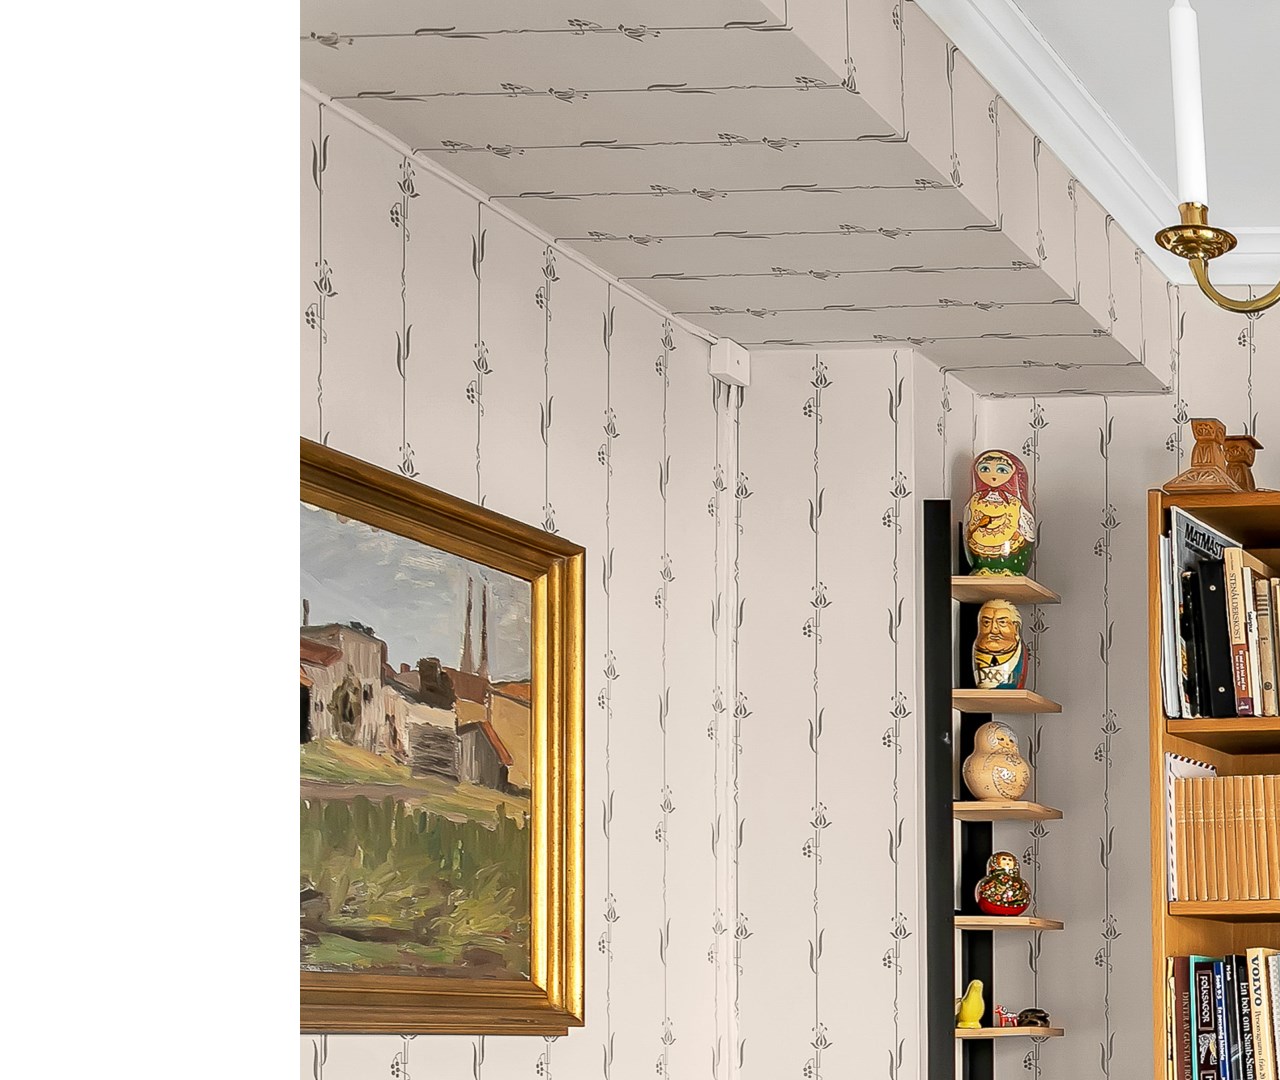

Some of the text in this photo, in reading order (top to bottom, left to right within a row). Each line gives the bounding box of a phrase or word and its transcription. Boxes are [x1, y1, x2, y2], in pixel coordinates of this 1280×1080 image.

[1229, 573, 1241, 640] STENÅLDERSKOST
[1240, 982, 1250, 995] En
[1251, 955, 1263, 1007] VOLVO
[1181, 991, 1190, 1020] DIKTER
[1241, 997, 1252, 1014] bok
[1183, 1021, 1191, 1030] AV
[1243, 1016, 1250, 1032] om
[1183, 1031, 1192, 1062] GUSTAF
